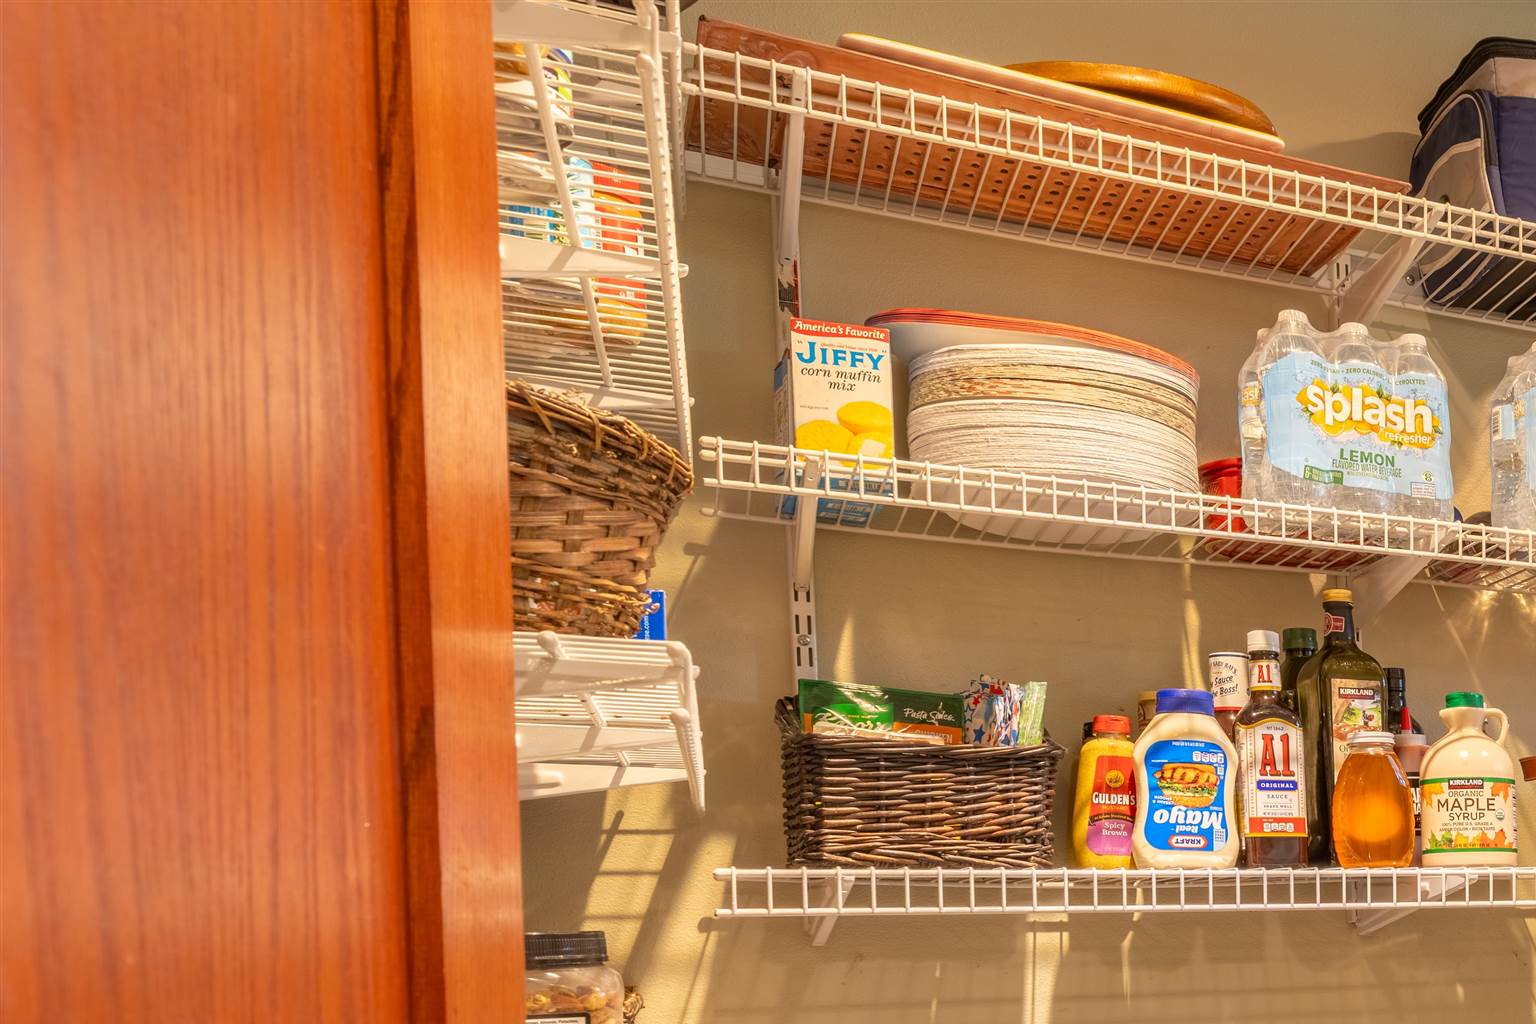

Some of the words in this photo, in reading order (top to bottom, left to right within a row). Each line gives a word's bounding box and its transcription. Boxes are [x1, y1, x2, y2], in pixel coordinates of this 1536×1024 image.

[794, 320, 843, 335] America's
[845, 326, 886, 340] Favorite
[800, 367, 831, 378] corn
[834, 369, 882, 384] muffin
[828, 379, 856, 392] mix
[1305, 383, 1433, 435] splash
[1384, 430, 1433, 445] refresher
[1339, 447, 1396, 467] LEMON
[1332, 458, 1360, 472] FLAVORED
[1214, 675, 1234, 686] Sauce
[1219, 683, 1239, 696] Boss!
[1339, 688, 1374, 696] KIRKLAND
[903, 706, 928, 720] Pasta
[1092, 790, 1136, 806] GULDEN'S
[1448, 790, 1484, 798] ORGANIC
[1437, 798, 1496, 812] MAPLE
[1153, 805, 1223, 830] Mayo
[1448, 812, 1486, 821] SYRUP
[1103, 821, 1126, 830] Spicy
[1175, 824, 1199, 833] Real
[1101, 828, 1128, 837] Brown
[1174, 837, 1201, 845] KRAFT
